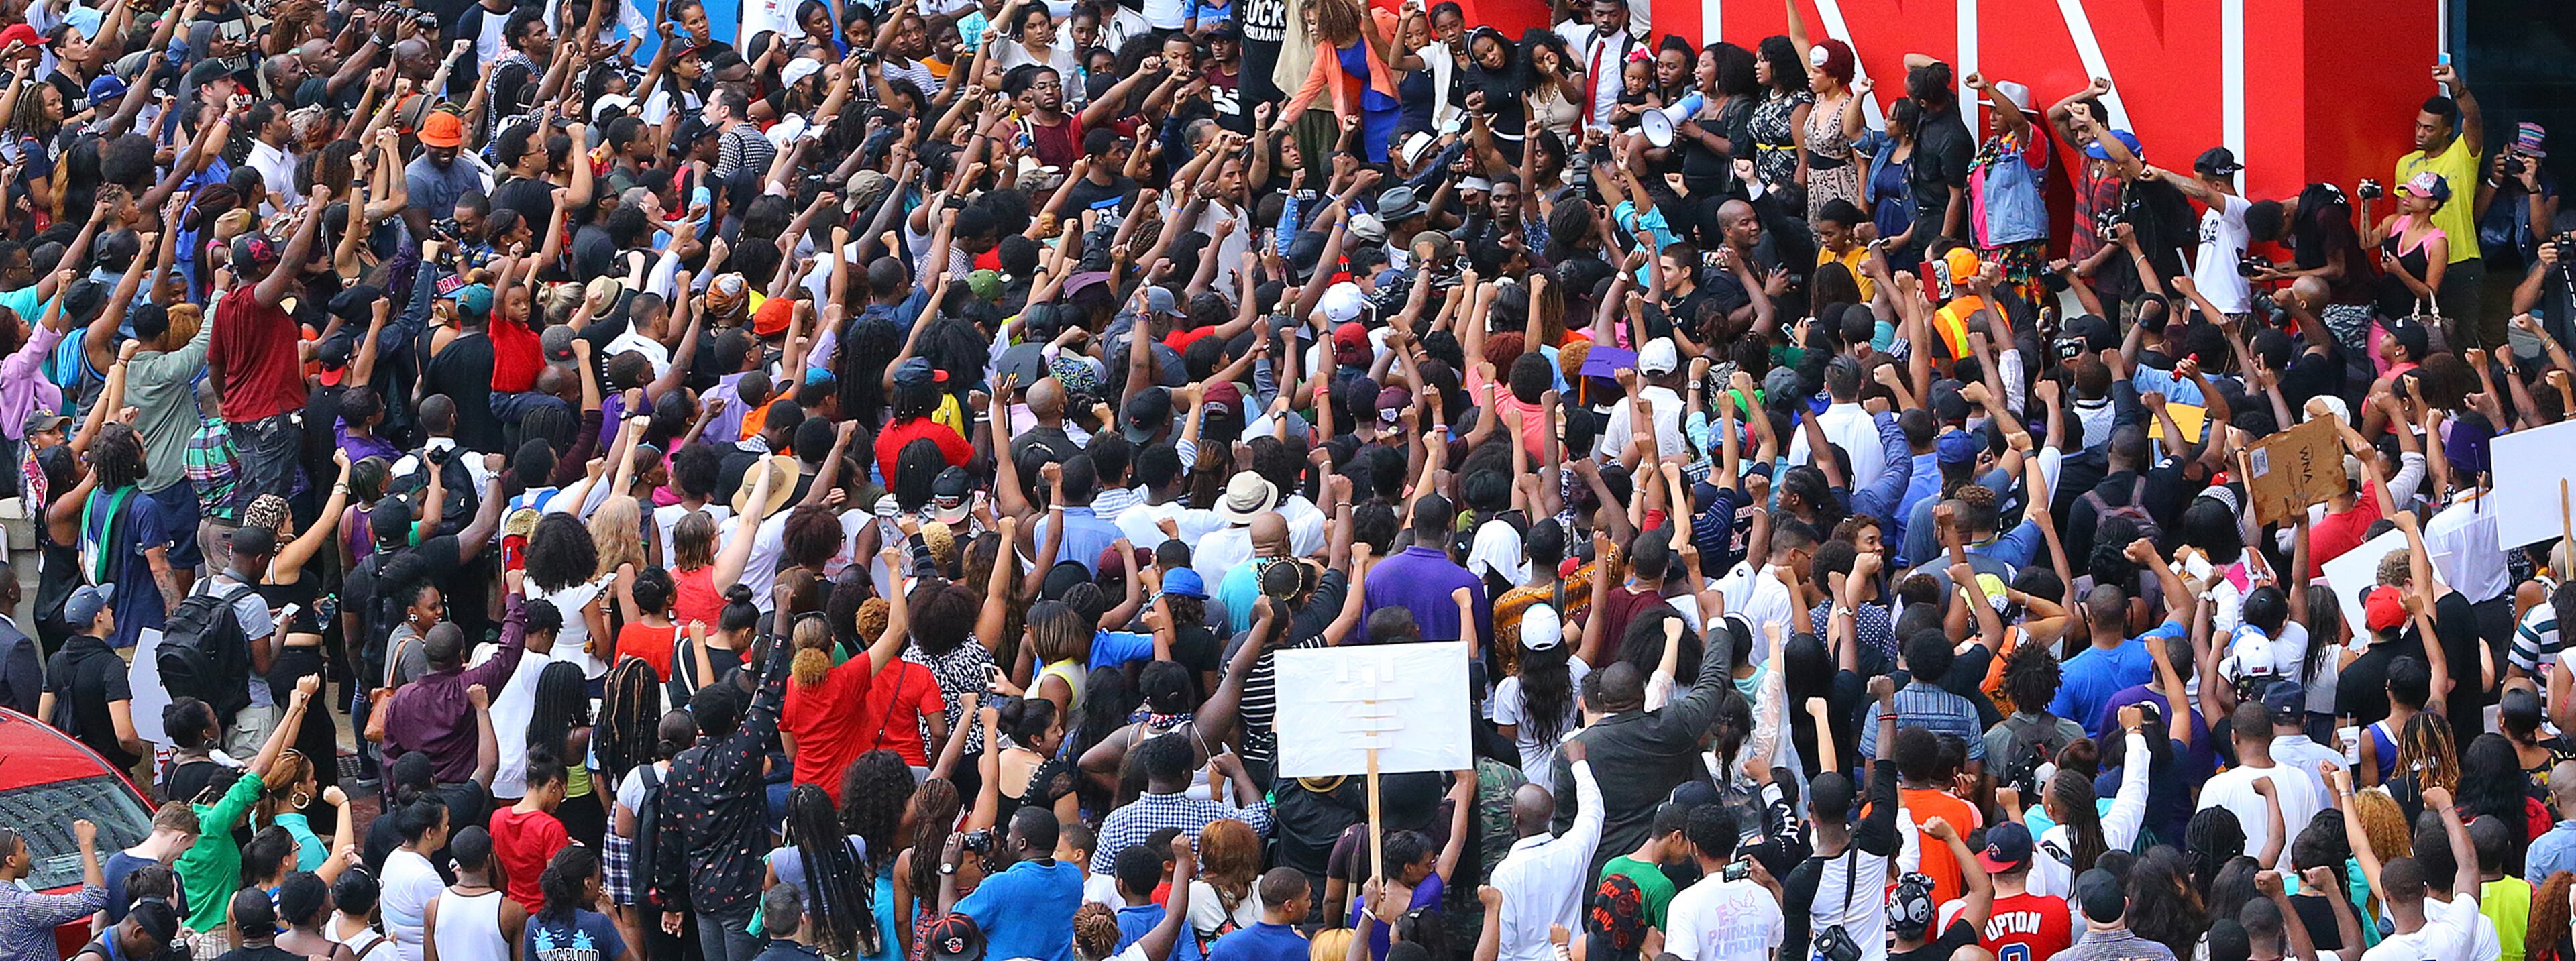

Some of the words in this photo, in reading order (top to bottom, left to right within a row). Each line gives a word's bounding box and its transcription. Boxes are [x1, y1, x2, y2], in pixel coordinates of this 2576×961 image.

[435, 273, 465, 295] OBAM
[2299, 445, 2313, 484] WNA
[1984, 911, 2041, 942] UPTON
